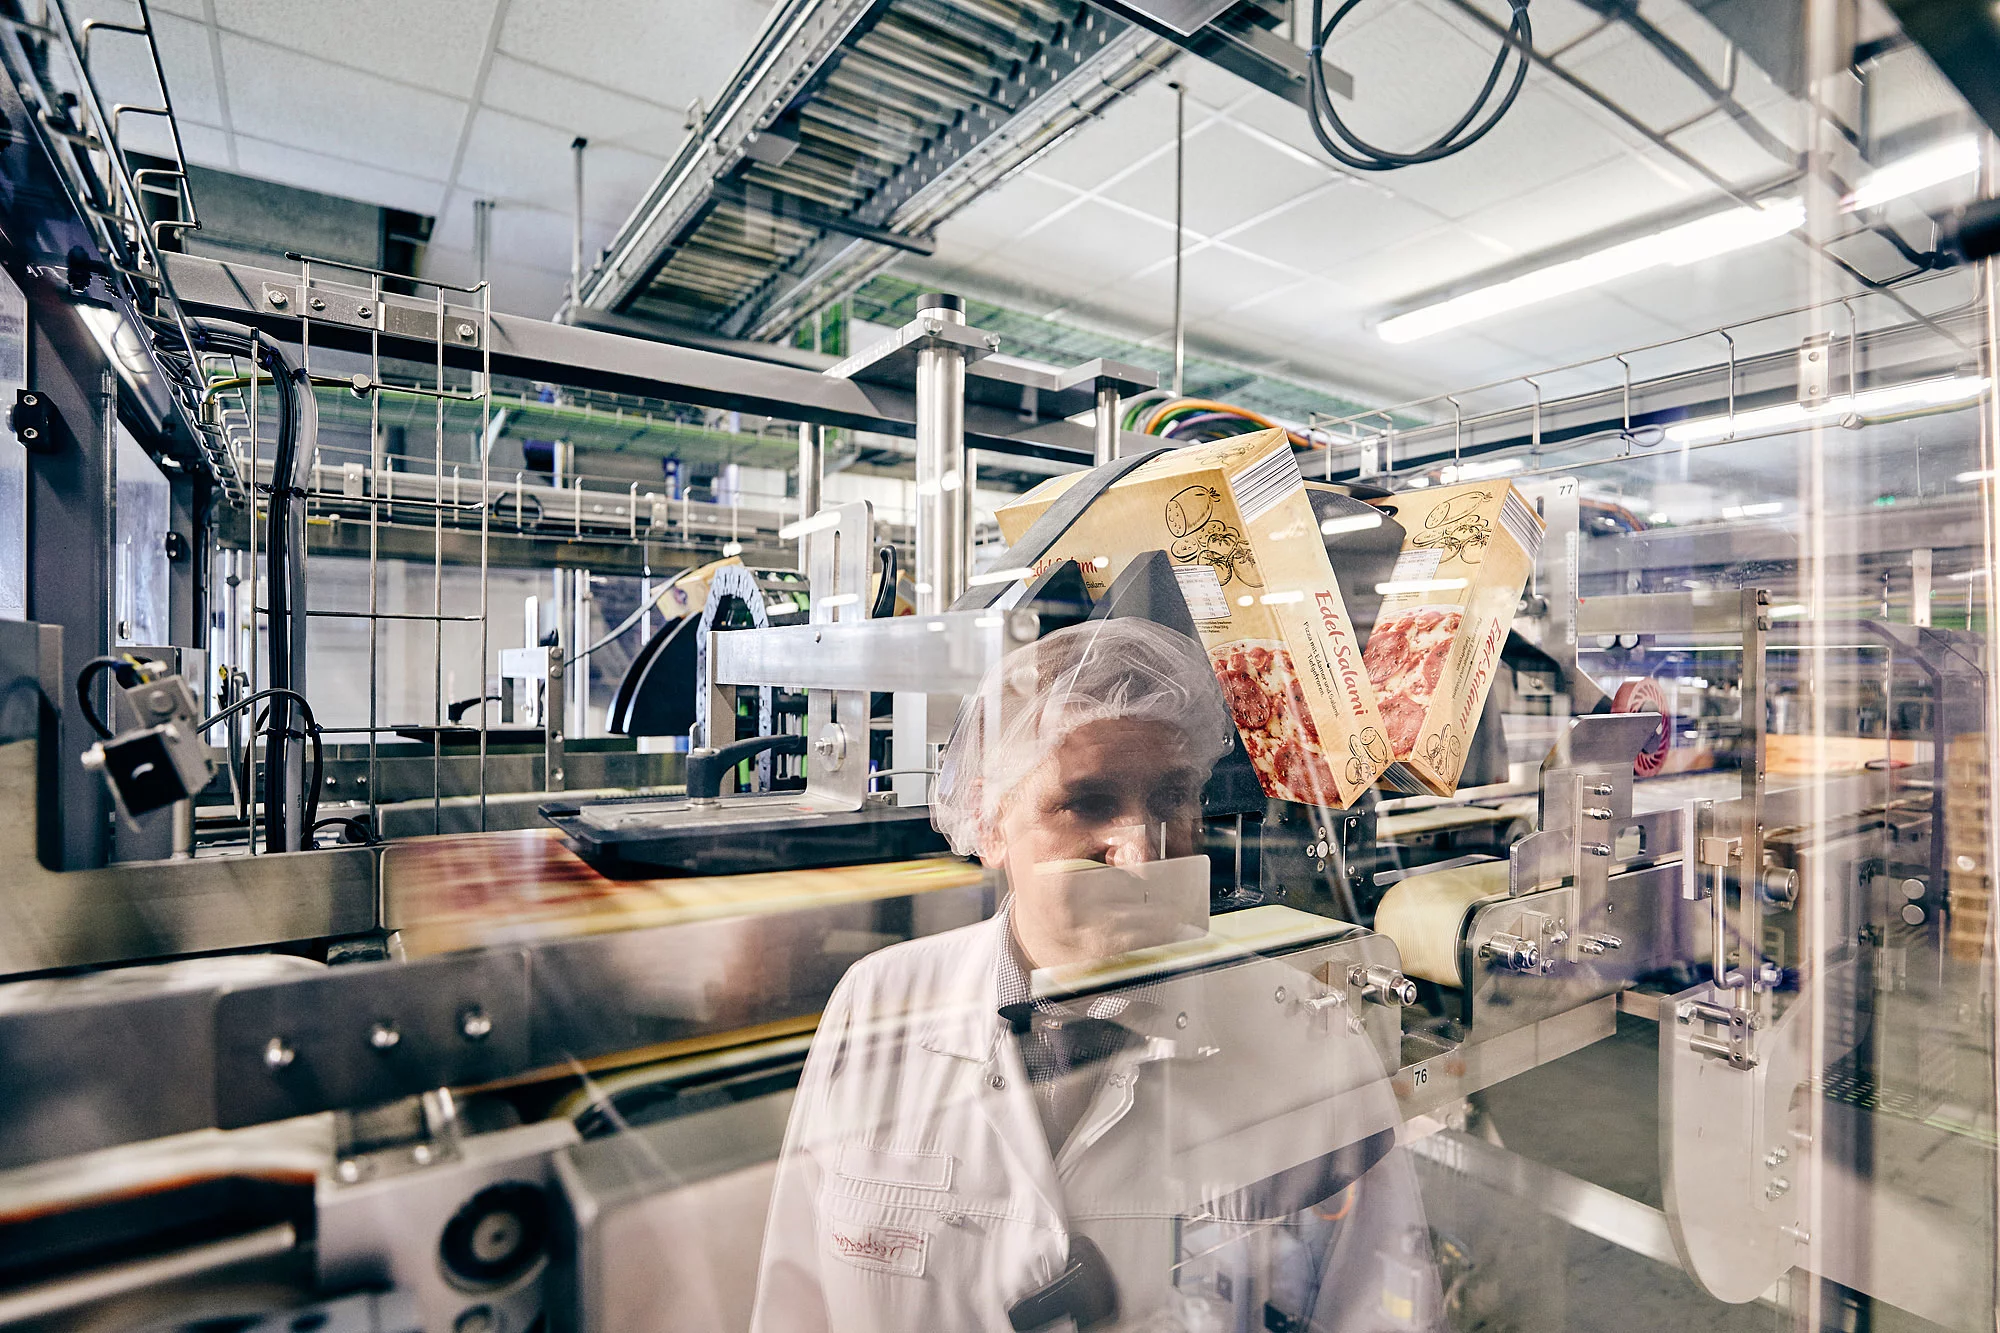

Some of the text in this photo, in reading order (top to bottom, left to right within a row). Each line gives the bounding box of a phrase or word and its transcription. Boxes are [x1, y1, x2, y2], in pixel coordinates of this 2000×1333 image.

[1559, 484, 1573, 496] 77
[1314, 589, 1369, 716] Edel-Salami
[1459, 616, 1502, 735] Edel-Salami
[1414, 1068, 1428, 1087] 76
